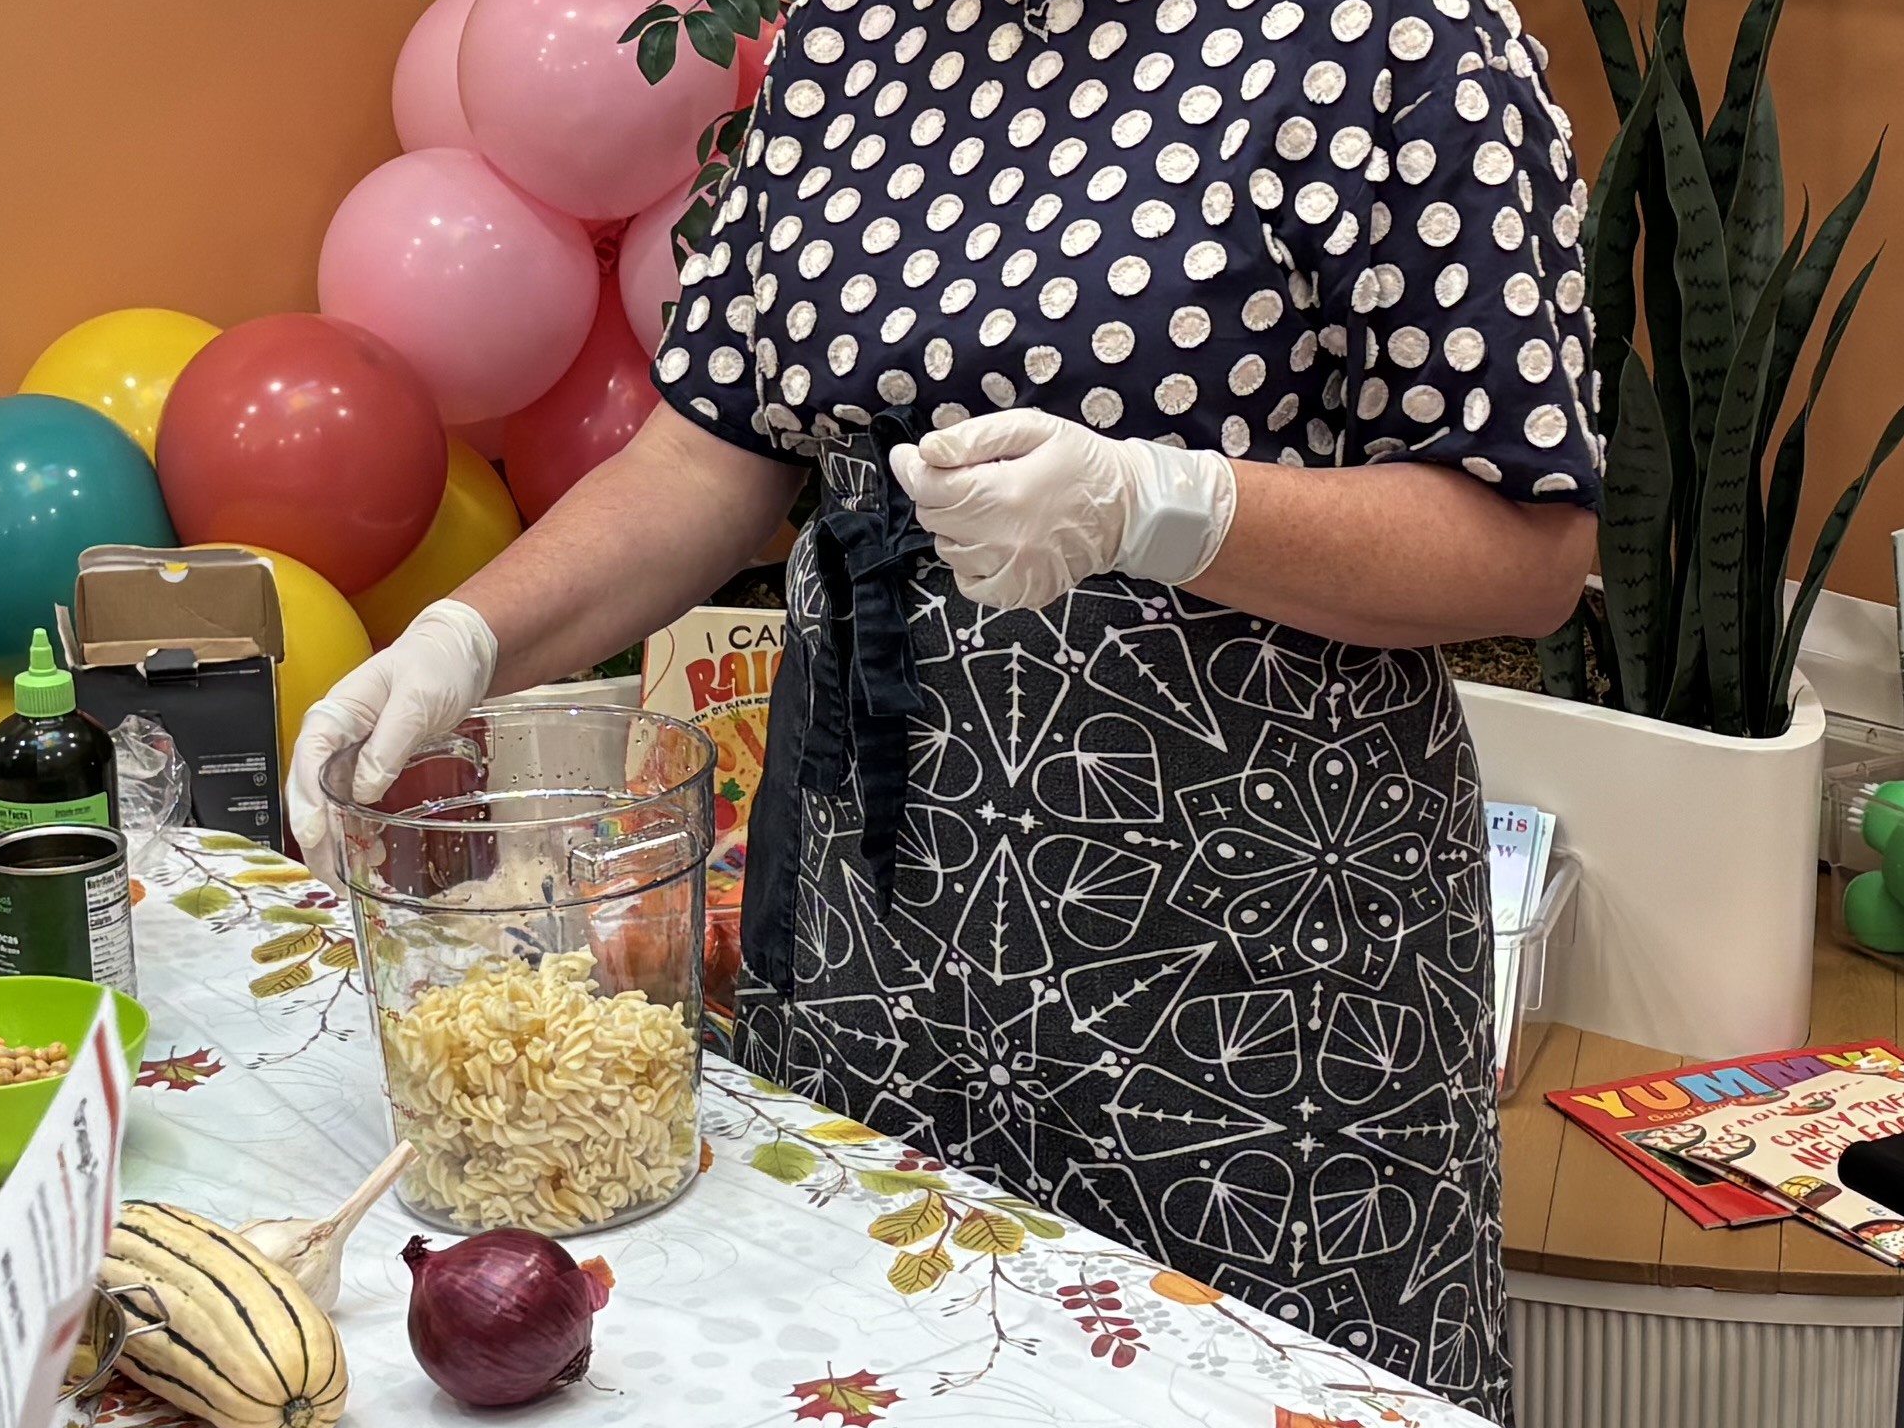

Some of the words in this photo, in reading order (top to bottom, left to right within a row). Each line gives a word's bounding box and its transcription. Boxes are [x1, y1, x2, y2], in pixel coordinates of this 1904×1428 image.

[706, 632, 714, 654] I
[1770, 1100, 1852, 1149] CARLY
[1790, 1133, 1850, 1171] NEW
